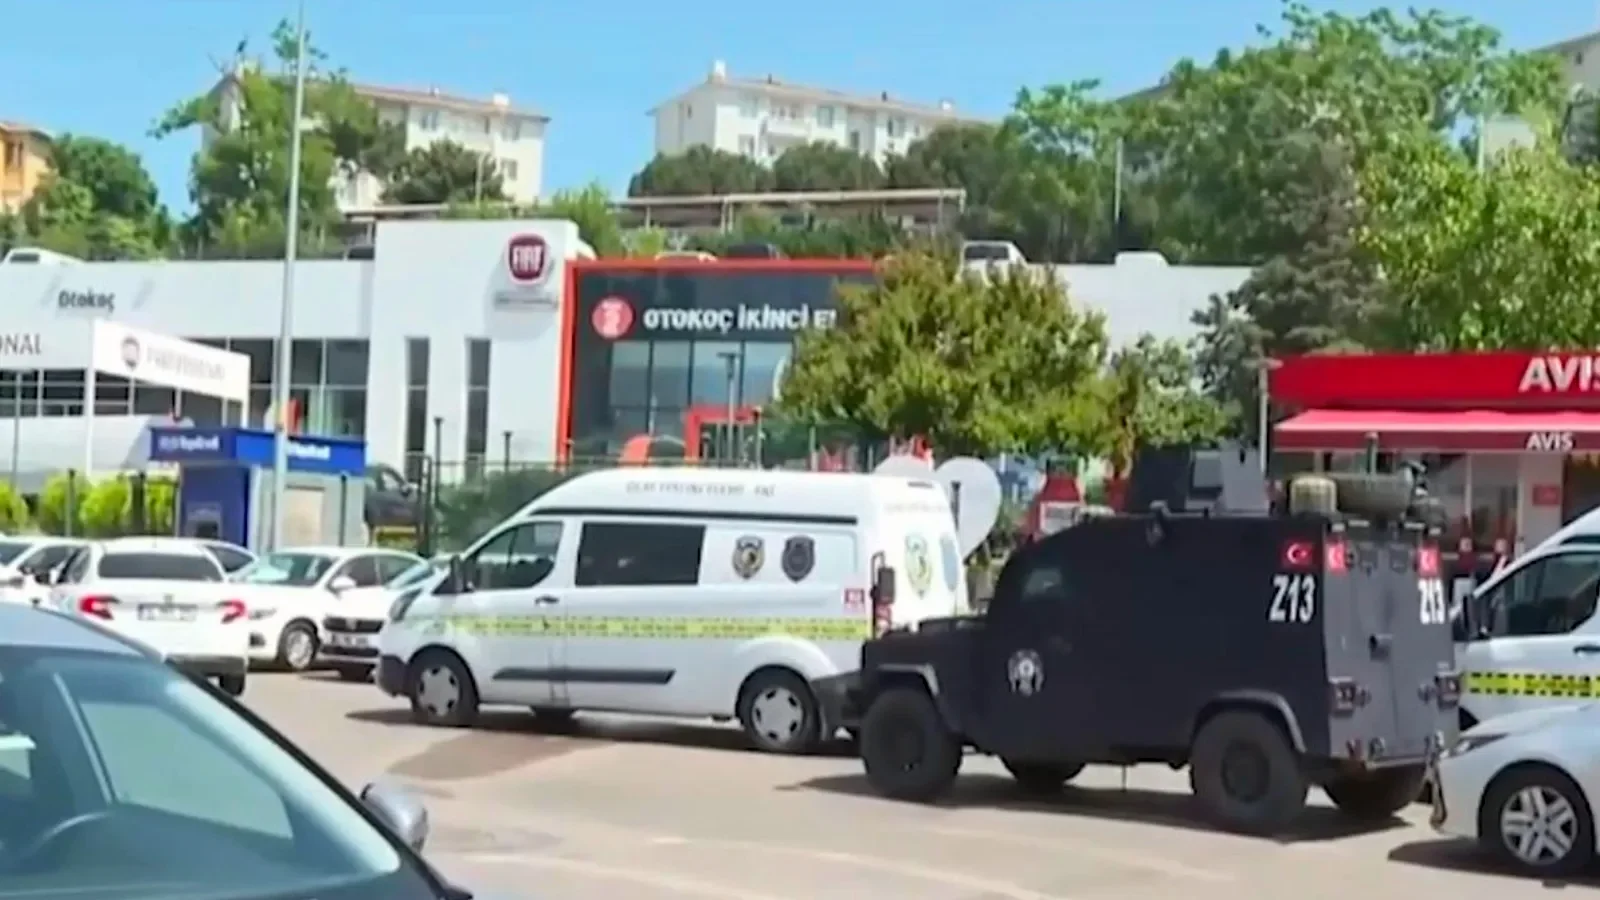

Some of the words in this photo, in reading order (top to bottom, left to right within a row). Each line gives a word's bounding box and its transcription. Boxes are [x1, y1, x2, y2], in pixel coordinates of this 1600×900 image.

[643, 308, 735, 336] OTOKOÇ
[738, 303, 809, 331] İKİNCİ
[0, 333, 41, 356] NAL
[1525, 431, 1574, 452] AVIS
[1268, 574, 1316, 624] Z13
